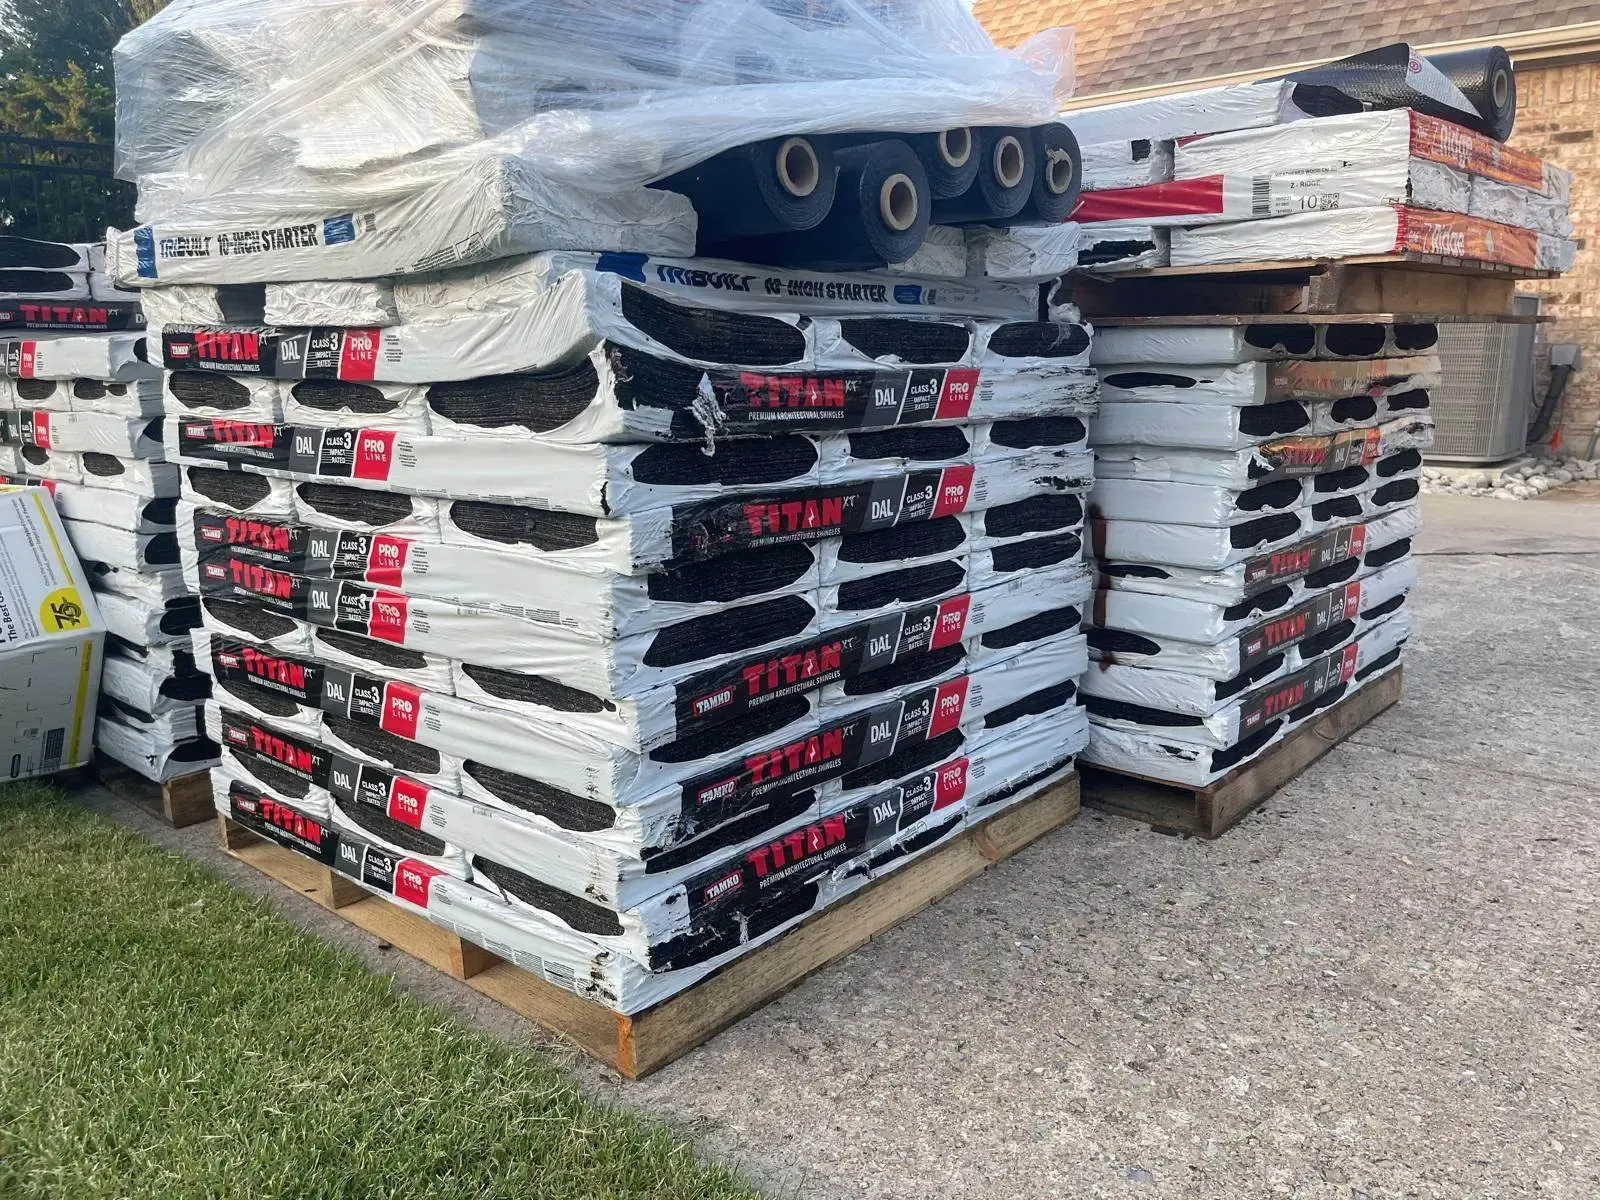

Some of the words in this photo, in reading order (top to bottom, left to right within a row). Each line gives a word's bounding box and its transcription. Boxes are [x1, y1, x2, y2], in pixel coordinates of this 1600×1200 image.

[1298, 194, 1318, 210] 10
[262, 223, 318, 251] STARTER
[1432, 224, 1465, 257] Ridge
[826, 283, 888, 303] STARTER
[19, 304, 107, 323] TITAN
[194, 332, 258, 360] TITAN
[281, 340, 300, 360] DAL
[312, 338, 330, 349] CLASS
[330, 332, 338, 350] 3
[351, 337, 372, 350] PRO
[350, 352, 372, 360] LINE
[740, 371, 846, 408] TITAN
[911, 384, 929, 394] CLASS
[930, 378, 938, 394] 3
[950, 382, 969, 394] PRO
[875, 388, 897, 406] DAL
[748, 412, 777, 420] PREMIUM
[820, 411, 844, 419] SHINGLES
[212, 417, 274, 448] TITAN
[326, 437, 344, 446] CLASS
[344, 432, 352, 449] 3
[296, 436, 314, 454] DAL
[364, 438, 384, 452] PRO
[366, 453, 386, 462] LINE
[906, 492, 924, 504] CLASS
[924, 485, 933, 500] 3
[945, 486, 964, 496] PRO
[946, 496, 964, 504] LINE
[743, 497, 842, 536] TITAN
[872, 499, 894, 520] DAL
[226, 518, 289, 552] TITAN
[816, 528, 840, 539] SHINGLES
[312, 540, 330, 558] DAL
[342, 541, 358, 550] CLASS
[358, 537, 366, 554] 3
[378, 544, 400, 558] PRO
[379, 558, 400, 568] LINE
[229, 558, 292, 599] TITAN
[312, 590, 331, 609] DAL
[342, 596, 358, 606] CLASS
[358, 594, 367, 610] 3
[0, 604, 12, 623] Best
[50, 600, 82, 629] 75
[378, 602, 400, 618] PRO
[942, 612, 960, 626] PRO
[380, 615, 400, 626] LINE
[904, 622, 922, 636] CLASS
[923, 616, 931, 632] 3
[942, 624, 960, 632] LINE
[6, 623, 18, 642] The
[1264, 614, 1306, 647] TITAN
[870, 634, 892, 657] DAL
[242, 648, 304, 689] TITAN
[742, 641, 842, 696] TITAN
[326, 681, 346, 701] DAL
[354, 688, 372, 698] CLASS
[371, 686, 380, 704] 3
[748, 692, 774, 709] PREMIUM
[775, 680, 816, 698] ARCHITECTURAL
[816, 670, 841, 685] SHINGLES
[392, 697, 412, 712] PRO
[696, 690, 730, 714] TAMKO
[904, 708, 922, 722] CLASS
[922, 700, 930, 716] 3
[942, 694, 960, 710] PRO
[942, 706, 960, 717] LINE
[392, 710, 412, 722] LINE
[870, 721, 892, 744] DAL
[250, 725, 312, 773] TITAN
[746, 728, 842, 784] TITAN
[816, 758, 842, 774] SHINGLES
[943, 768, 960, 782] PRO
[334, 770, 352, 790] DAL
[362, 782, 378, 791] CLASS
[378, 782, 386, 796] 3
[906, 784, 923, 798] CLASS
[924, 776, 932, 792] 3
[944, 777, 963, 790] LINE
[398, 793, 418, 806] PRO
[700, 780, 735, 804] TAMKO
[398, 803, 418, 816] LINE
[872, 800, 896, 824] DAL
[259, 798, 320, 845] TITAN
[340, 843, 358, 864] DAL
[747, 812, 846, 877] TITAN
[384, 858, 392, 872] 3
[760, 871, 785, 890] PREMIUM
[784, 854, 823, 877] ARCHITECTURAL
[823, 842, 846, 860] SHINGLES
[403, 869, 422, 886] PRO
[706, 874, 739, 899] TAMKO
